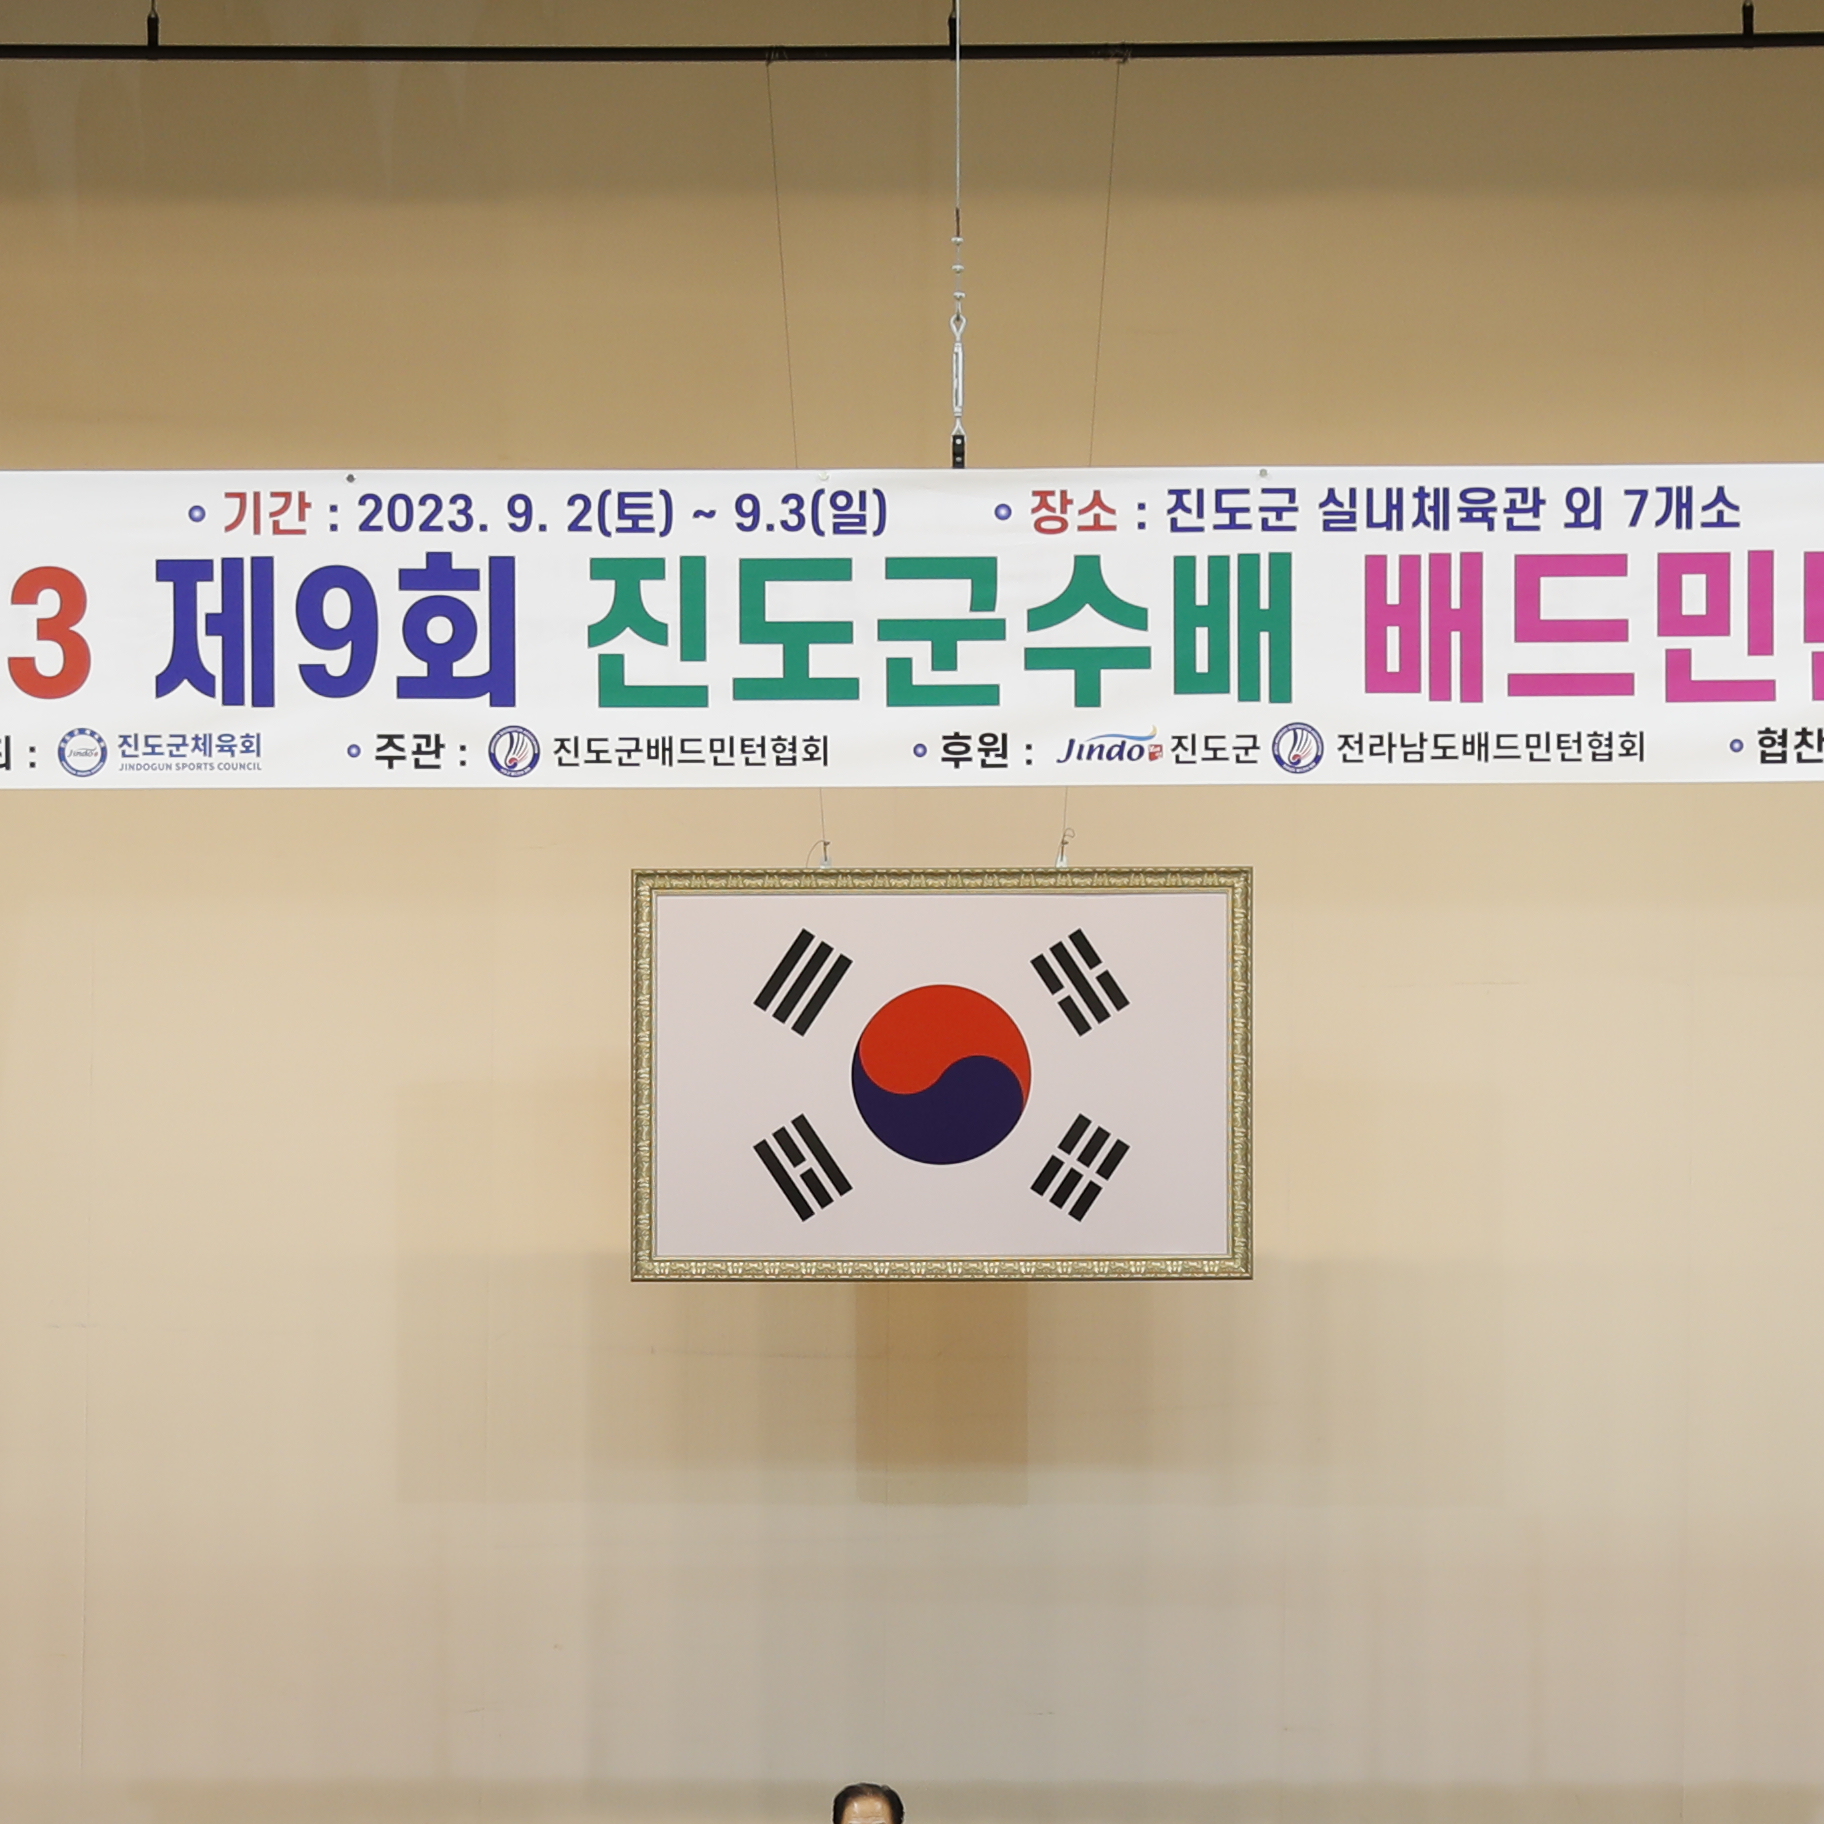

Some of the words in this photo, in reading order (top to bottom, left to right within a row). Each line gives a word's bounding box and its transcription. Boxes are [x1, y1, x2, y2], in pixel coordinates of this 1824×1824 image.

[225, 491, 311, 535] 기간
[358, 493, 487, 532] 2023.
[567, 489, 673, 537] 2(토)
[735, 488, 886, 537] 9.3(일)
[1031, 490, 1117, 534] 장소
[1167, 488, 1299, 533] 진도군
[1319, 486, 1546, 532] 실내체육관
[1564, 486, 1601, 530] 외
[1624, 486, 1740, 530] 7개소
[155, 552, 516, 707] 제9회
[588, 552, 1292, 708] 진도군수배
[118, 733, 260, 758] 진도군체육회
[375, 734, 445, 769] 주관
[554, 735, 828, 767] 진도군배드민턴협회
[941, 732, 1008, 769] 후원
[1056, 734, 1147, 764] Jindo
[1171, 733, 1260, 764] 진도군
[1337, 731, 1644, 763] 전라남도배드민턴협회
[119, 763, 172, 771] JINDOGUN
